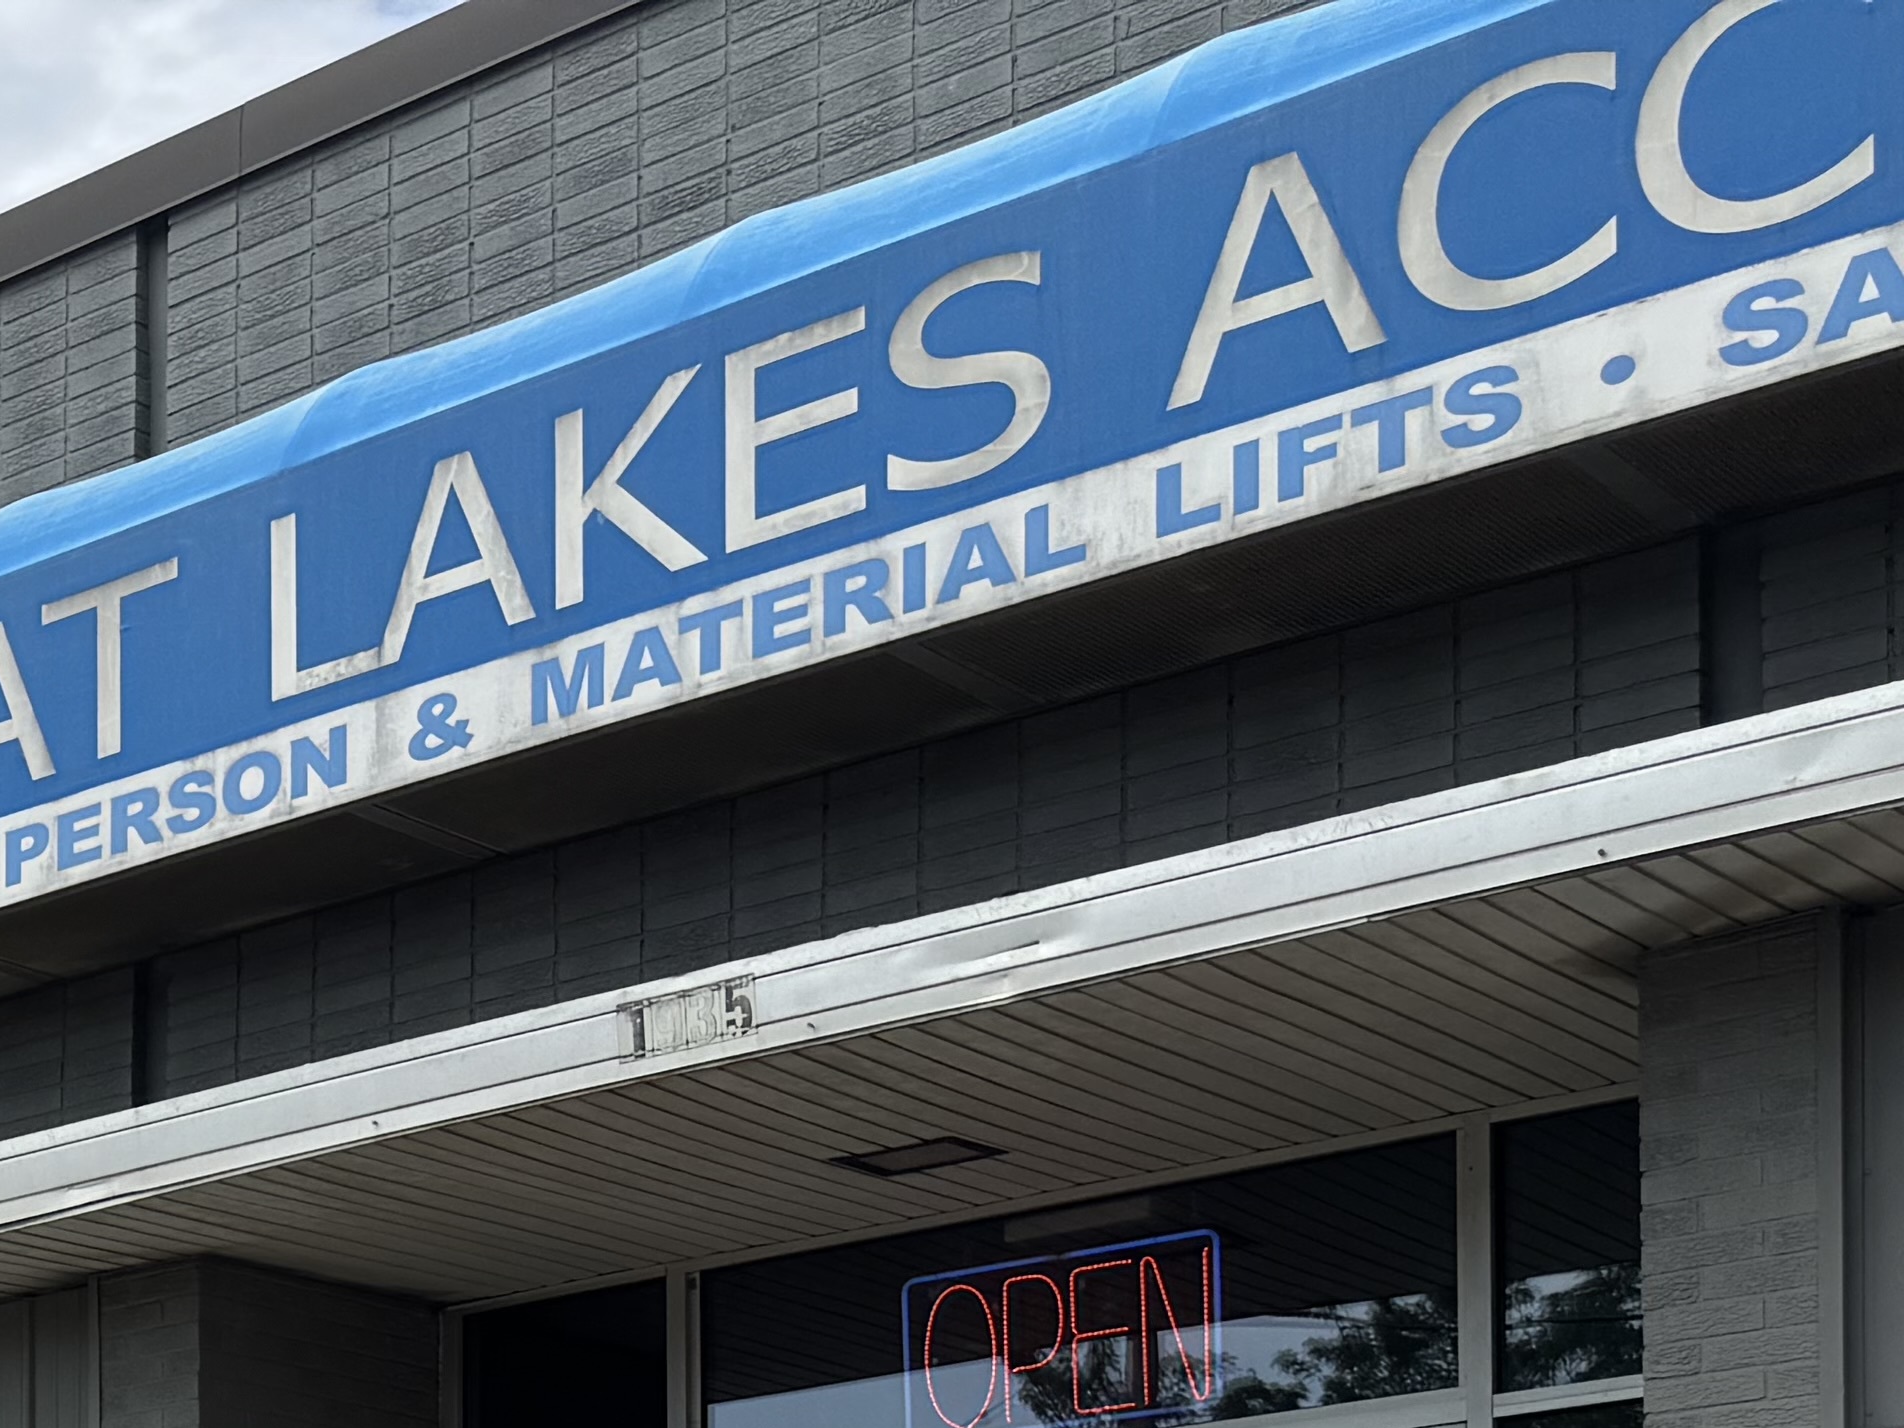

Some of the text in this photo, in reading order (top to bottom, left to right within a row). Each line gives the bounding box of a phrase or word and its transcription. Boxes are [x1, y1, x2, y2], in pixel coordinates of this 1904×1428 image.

[5, 723, 349, 888] PERSON
[408, 692, 474, 762] &
[531, 504, 1087, 726] MATERIAL
[1155, 364, 1523, 538] LIFTS
[270, 250, 1052, 702] LAKES
